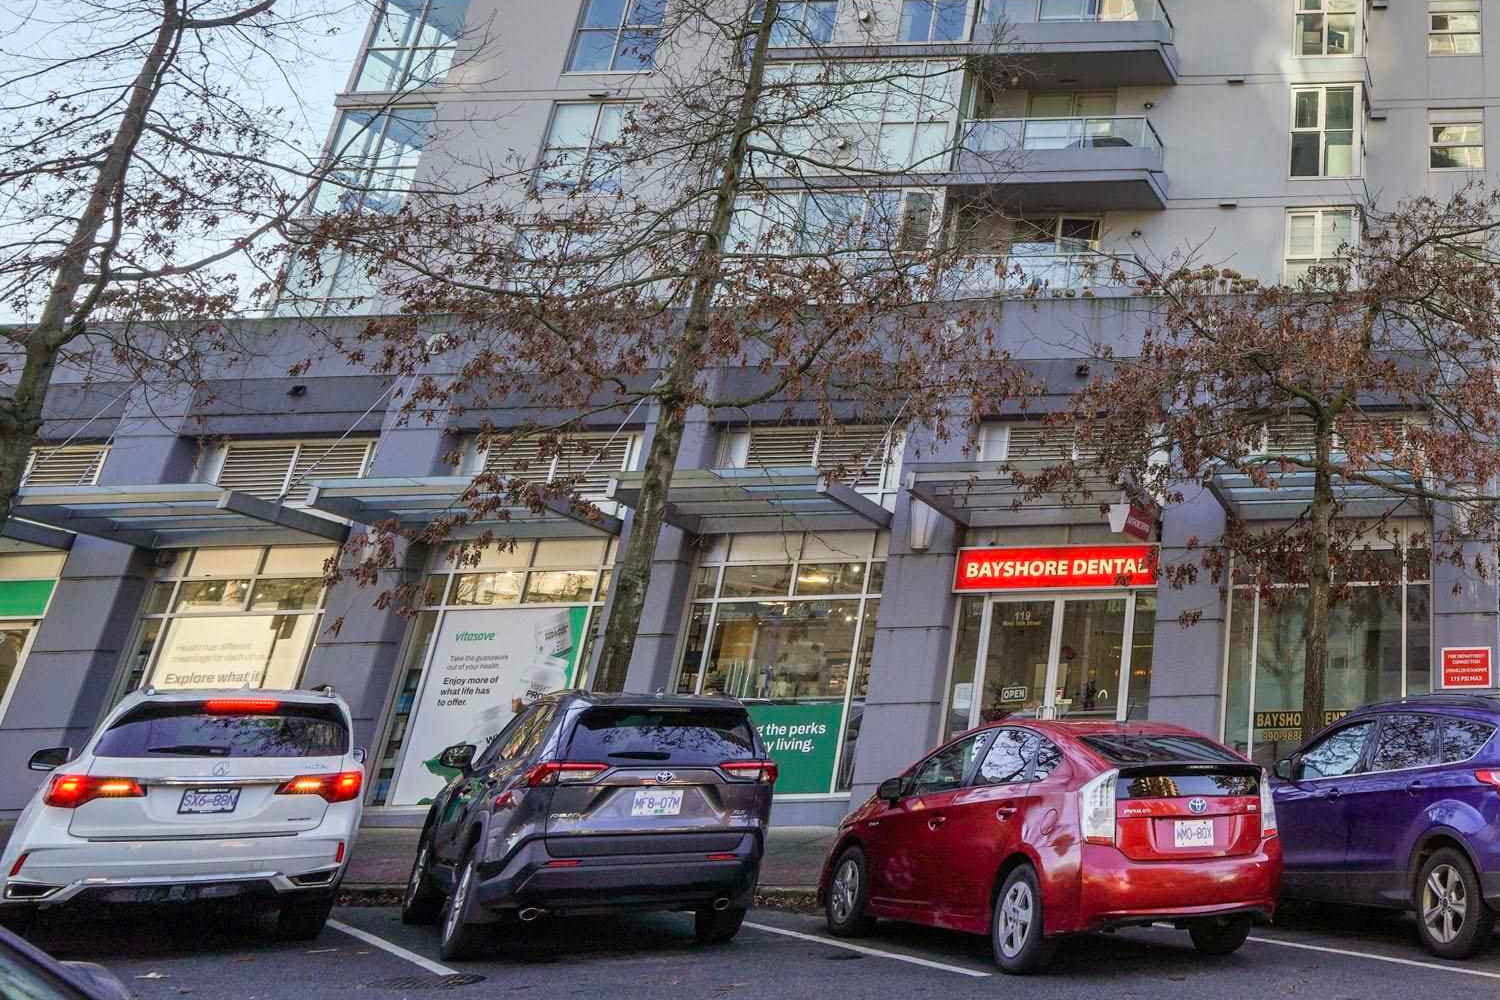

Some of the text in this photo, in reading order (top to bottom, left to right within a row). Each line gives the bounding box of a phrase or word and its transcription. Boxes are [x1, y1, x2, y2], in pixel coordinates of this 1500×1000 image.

[966, 558, 1149, 578] BAYSHORE DENTAL
[164, 670, 260, 686] Explore what it
[443, 676, 499, 686] Enjoy more of
[440, 688, 459, 696] what
[461, 687, 474, 695] life
[1003, 689, 1025, 699] OPEN
[447, 698, 467, 707] offer.
[1256, 713, 1301, 727] BAYSHO
[766, 724, 786, 735] the
[788, 722, 827, 737] perks
[776, 738, 815, 753] living.
